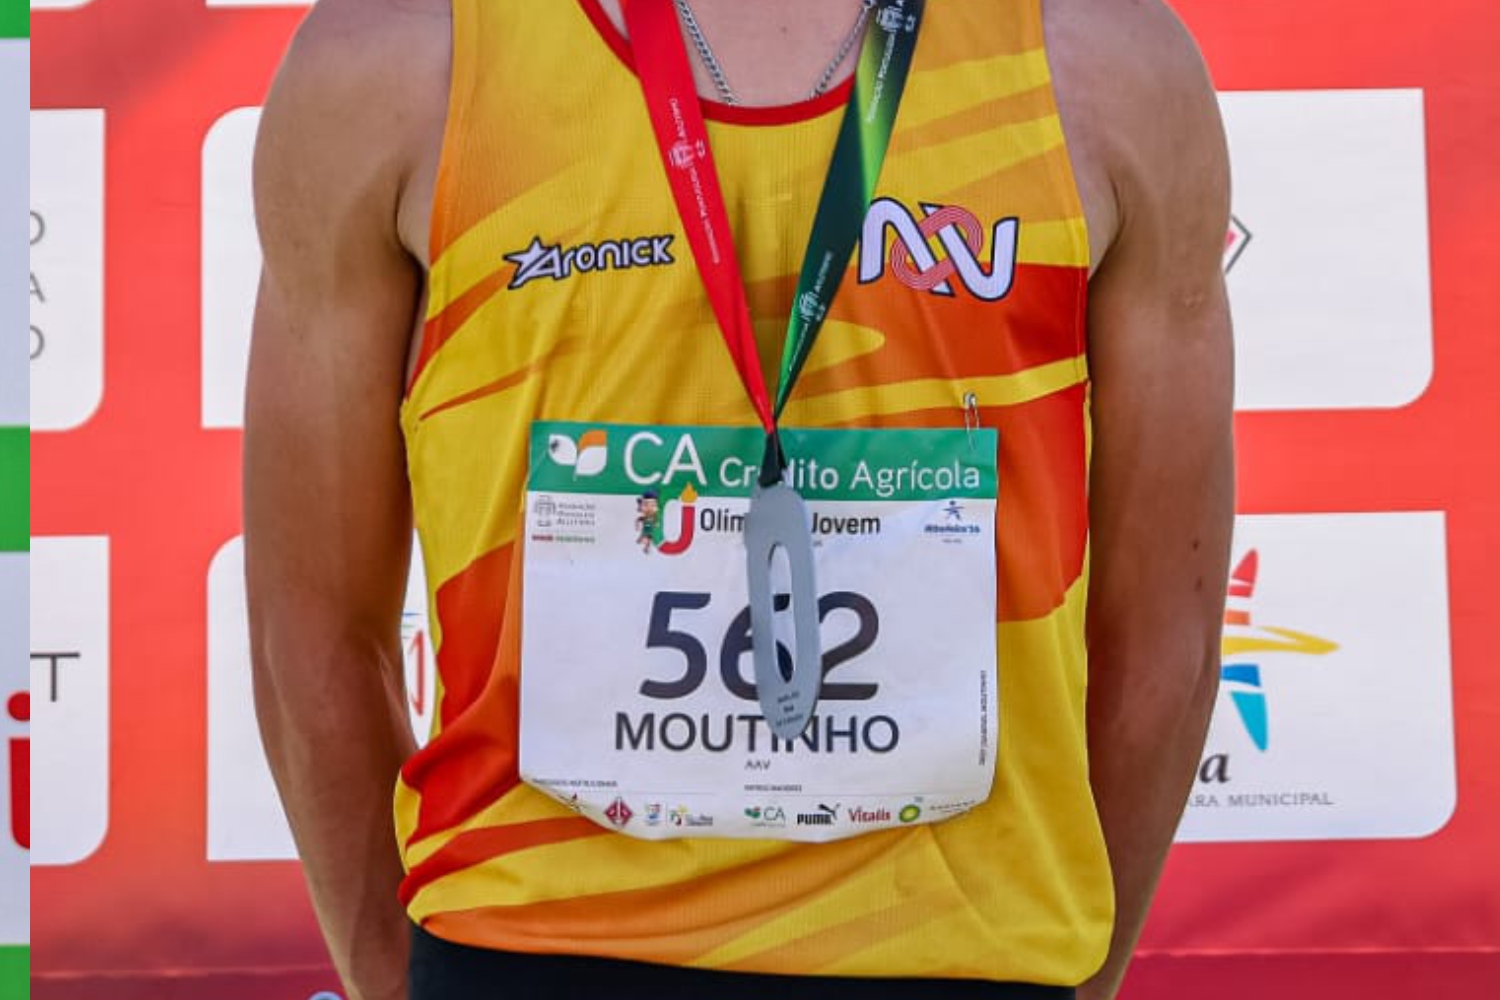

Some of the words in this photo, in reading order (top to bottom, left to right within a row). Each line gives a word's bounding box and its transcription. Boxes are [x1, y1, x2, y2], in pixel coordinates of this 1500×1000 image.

[624, 431, 707, 486] CA
[849, 459, 980, 497] Agrícola
[810, 512, 881, 535] Jovem
[1229, 792, 1334, 806] MUNICIPAL
